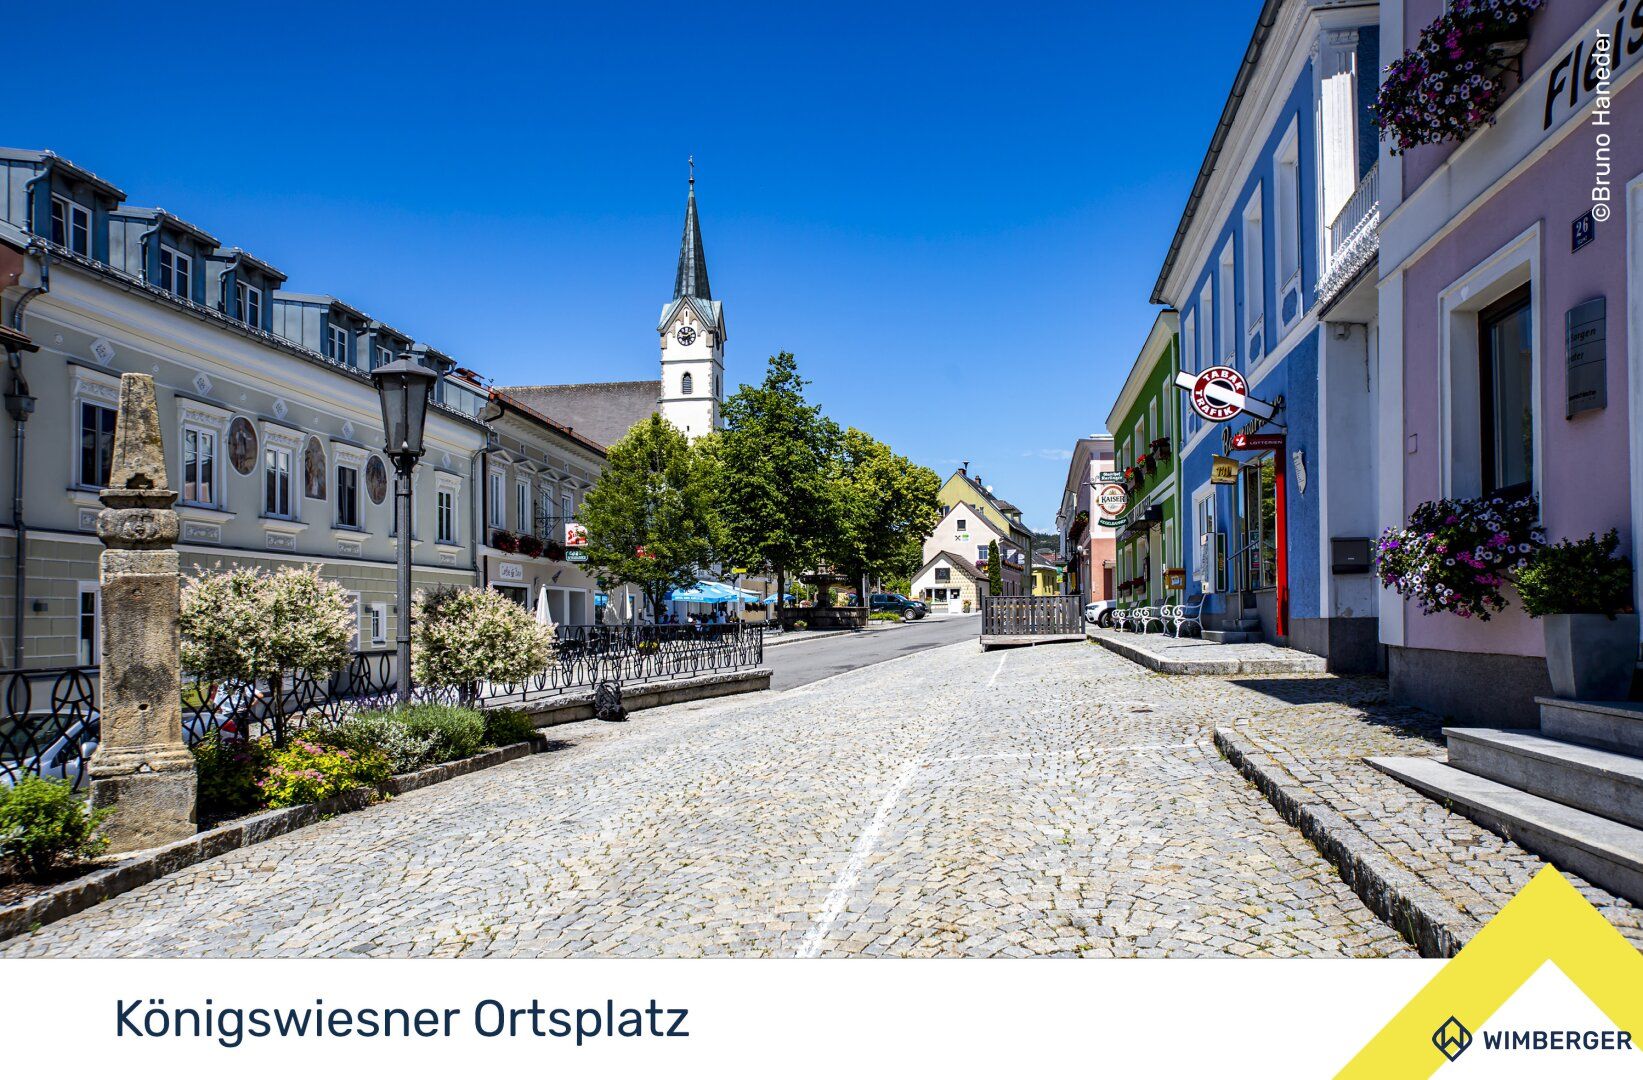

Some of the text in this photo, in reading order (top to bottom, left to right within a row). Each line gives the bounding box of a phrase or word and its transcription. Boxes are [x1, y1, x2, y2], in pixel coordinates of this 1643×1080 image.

[1576, 216, 1589, 237] 26
[1202, 370, 1244, 390] TABAK
[1195, 389, 1234, 417] TRAFIK
[1101, 495, 1125, 504] KAISER
